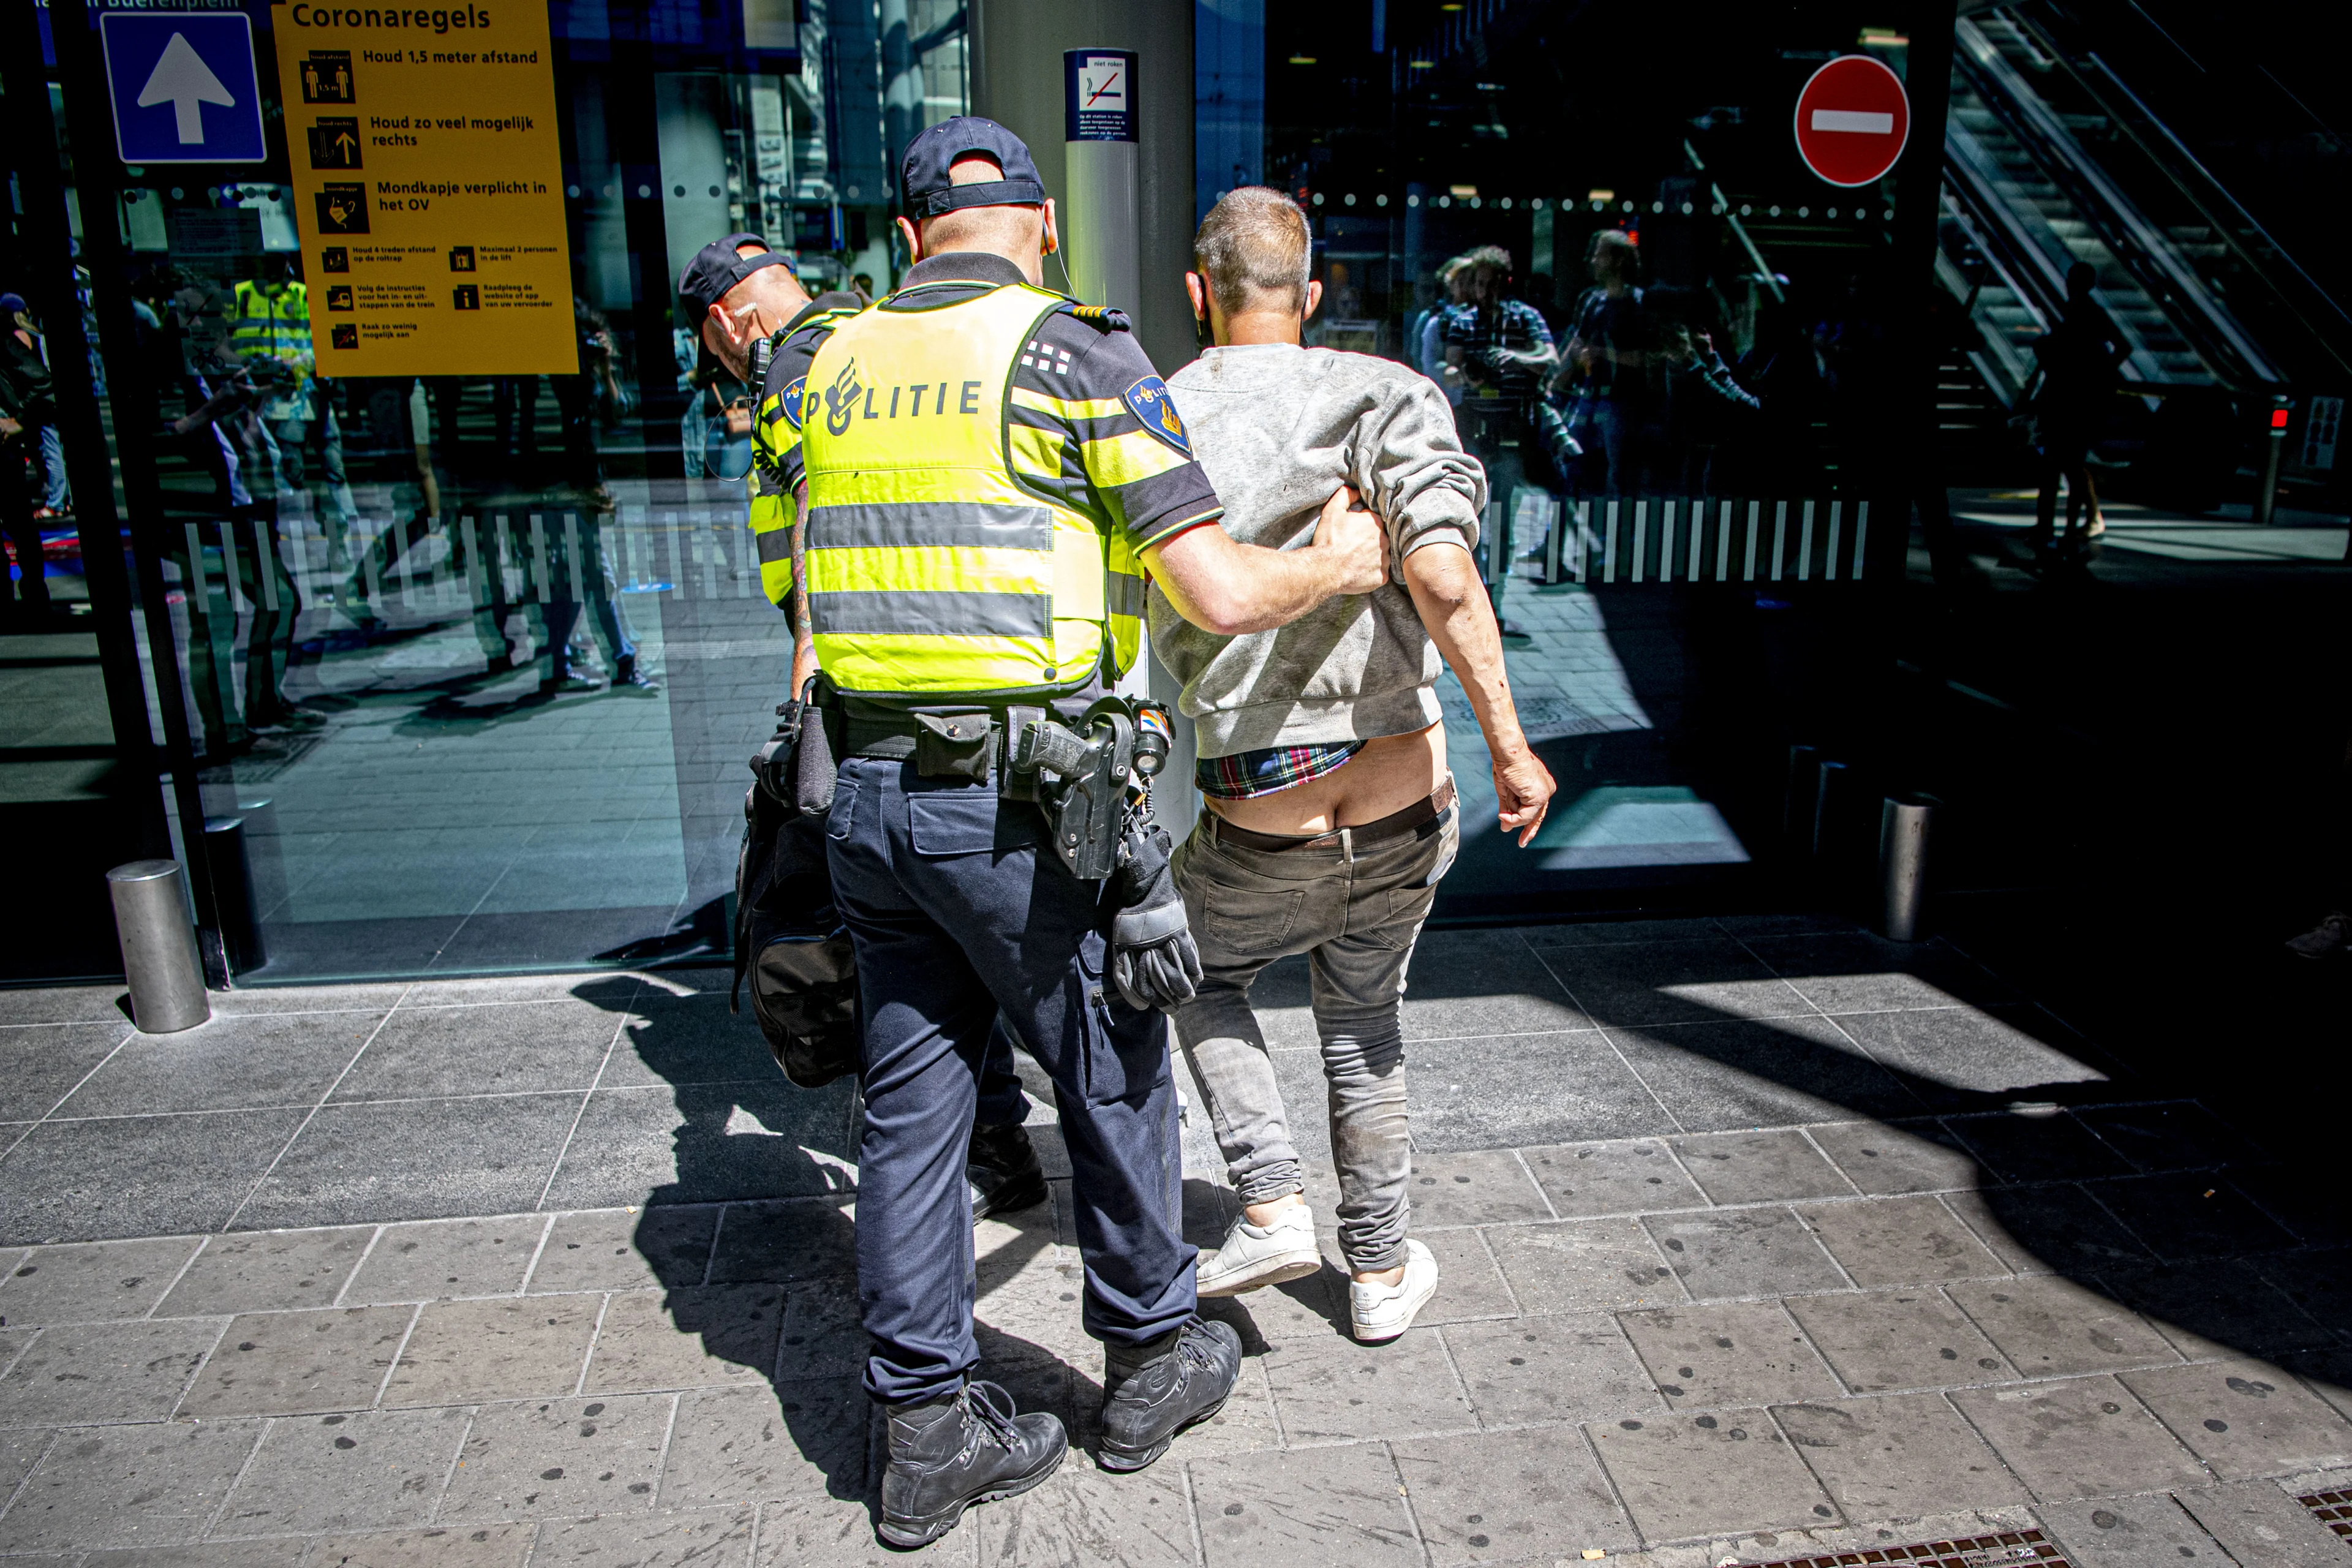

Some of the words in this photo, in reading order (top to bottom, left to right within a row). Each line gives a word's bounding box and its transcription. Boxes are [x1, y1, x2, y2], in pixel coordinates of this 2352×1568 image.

[292, 3, 490, 34] Coronaregels
[363, 50, 403, 63] Houd
[408, 50, 428, 64] 1,5
[433, 51, 477, 64] meter
[481, 50, 538, 64] afstand
[370, 116, 410, 129] Houd
[415, 119, 432, 129] zo
[435, 116, 467, 129] veel
[471, 116, 534, 132] mogelijk
[372, 134, 418, 146] rechts
[377, 181, 460, 197] Mondkapje
[464, 181, 529, 197] verplicht
[533, 181, 547, 194] in
[379, 198, 404, 211] het
[408, 198, 429, 211] OV
[805, 381, 982, 437] POLITIE
